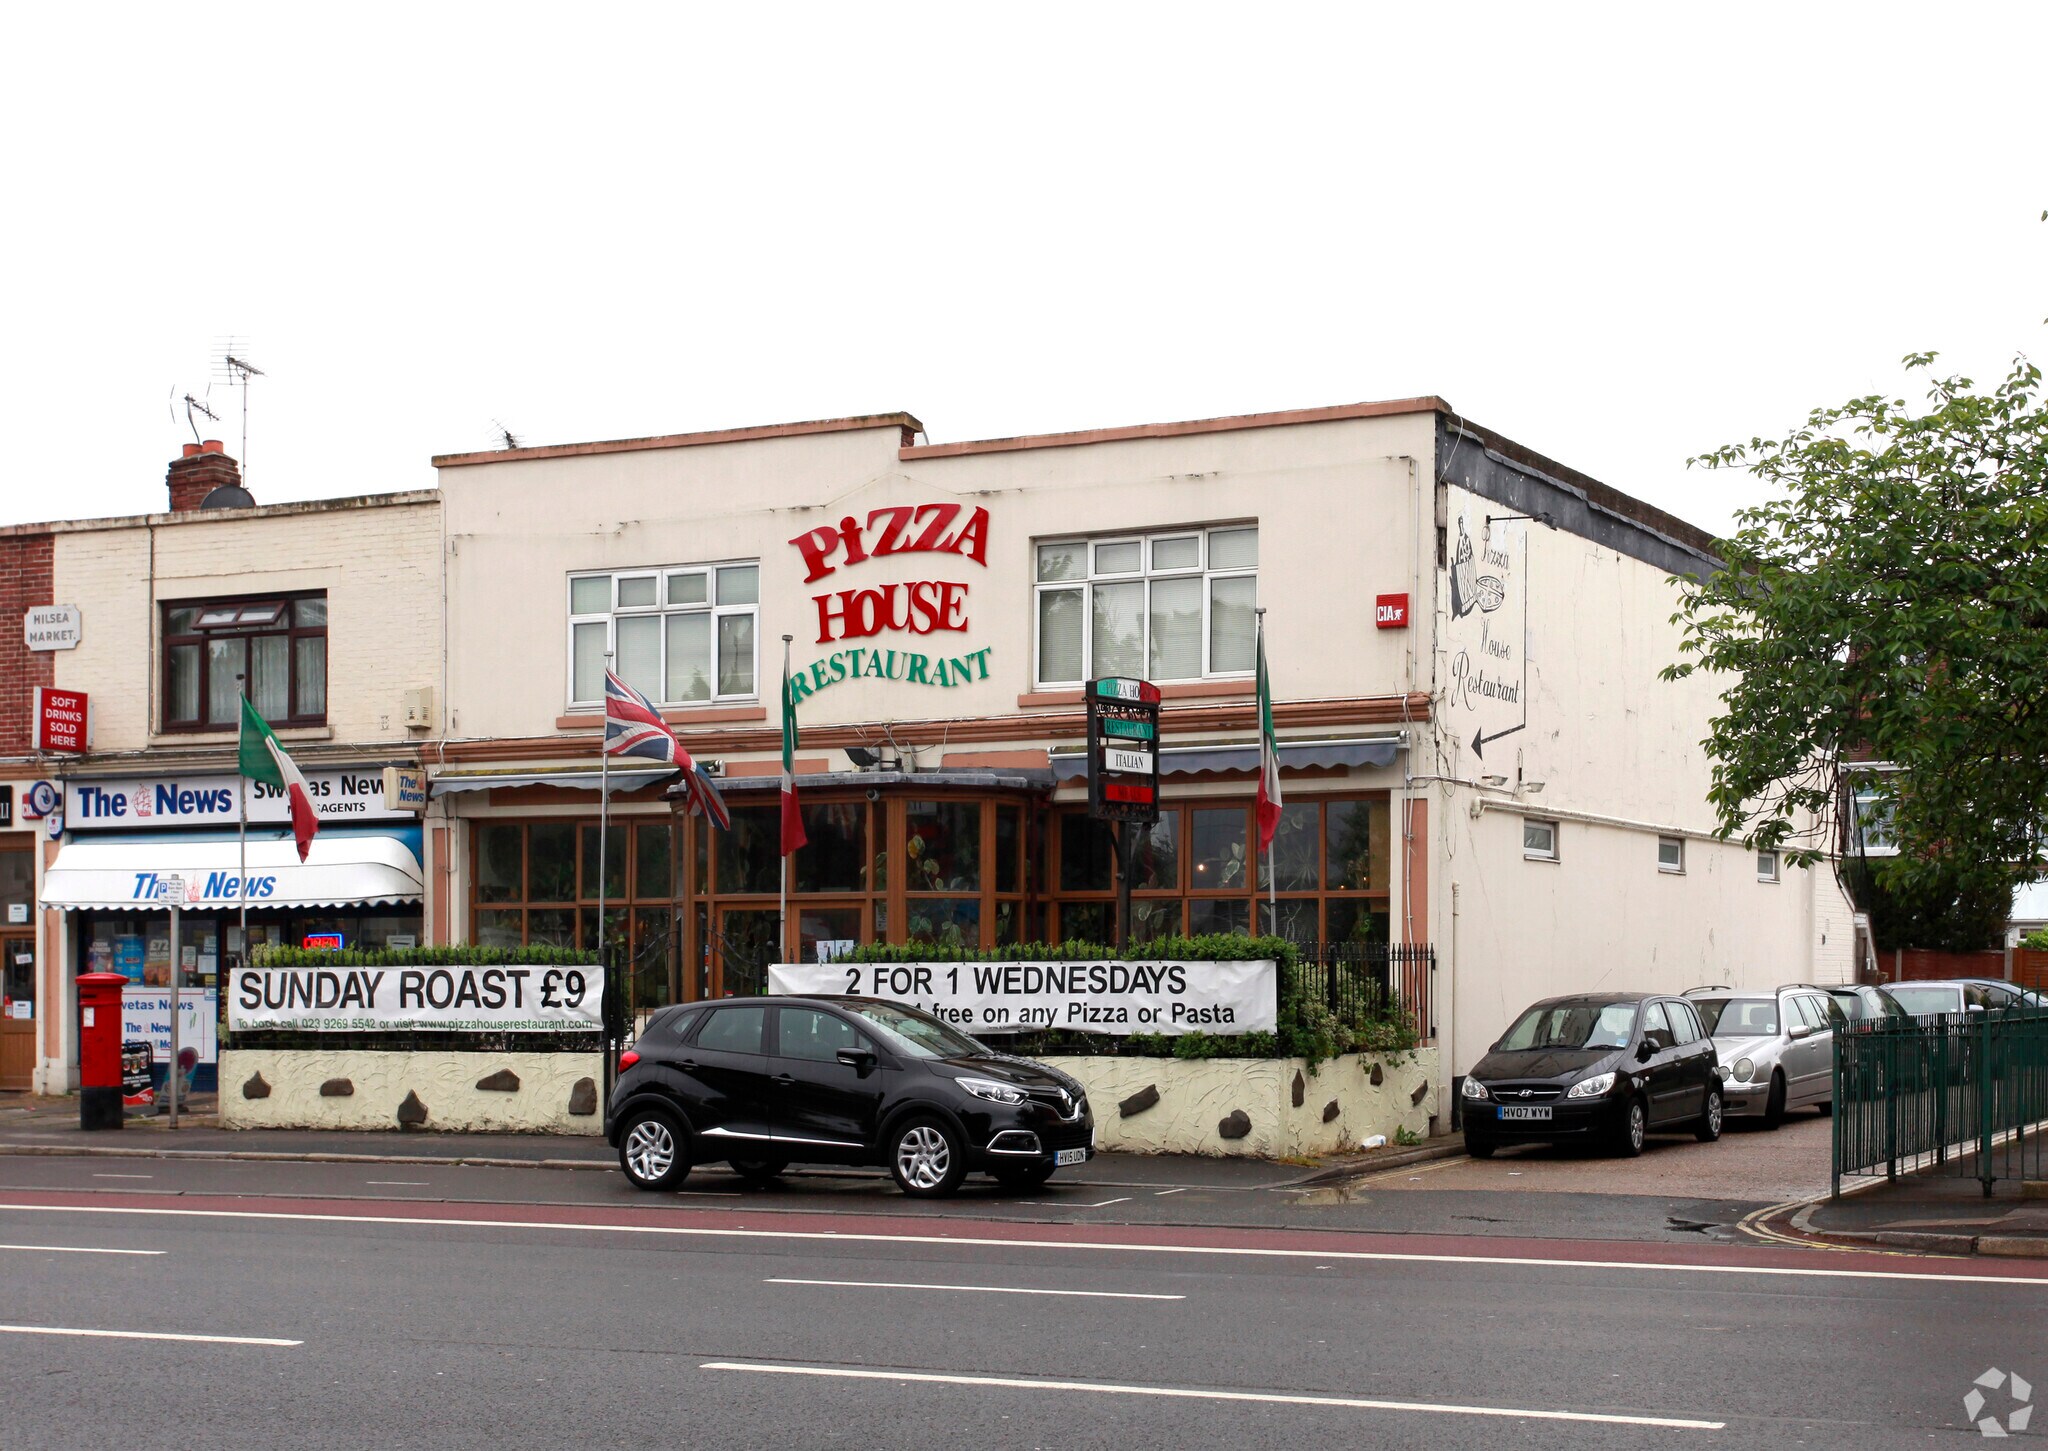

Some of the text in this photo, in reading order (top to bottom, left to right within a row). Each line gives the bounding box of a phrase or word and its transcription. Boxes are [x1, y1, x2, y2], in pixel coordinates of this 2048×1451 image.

[33, 612, 69, 625] HILSEA
[811, 580, 969, 644] HOUSE
[1377, 605, 1394, 622] CIA
[1480, 617, 1511, 661] House
[790, 646, 992, 705] RESTAURANT
[1450, 648, 1519, 711] Restaurant
[1106, 680, 1127, 697] PIZZA
[51, 696, 77, 709] SOFT
[45, 708, 82, 722] DRINKS
[50, 722, 77, 734] SOLD
[1106, 719, 1153, 739] RESTAURANT
[50, 734, 77, 747] HERE
[1115, 753, 1144, 769] ITALIAN
[254, 775, 384, 799] Swas New
[400, 775, 416, 789] The
[77, 783, 232, 818] The News
[399, 788, 424, 803] News
[133, 873, 158, 899] Th
[203, 871, 277, 898] News
[303, 936, 339, 950] OPEN
[845, 965, 1187, 995] 2 FOR 1 WEDNESDAYS
[239, 969, 586, 1010] SUNDAY ROAST £9
[237, 1018, 248, 1029] To
[252, 1018, 276, 1029] book
[280, 1018, 298, 1029] call
[302, 1018, 321, 1029] 023
[324, 1018, 348, 1029] 9269
[352, 1018, 376, 1029] 5542
[379, 1020, 390, 1029] or
[394, 1018, 416, 1029] visit
[932, 1002, 1236, 1028] free on any Pizza or Pasta
[125, 1022, 142, 1033] The
[1503, 1107, 1528, 1118] HV07
